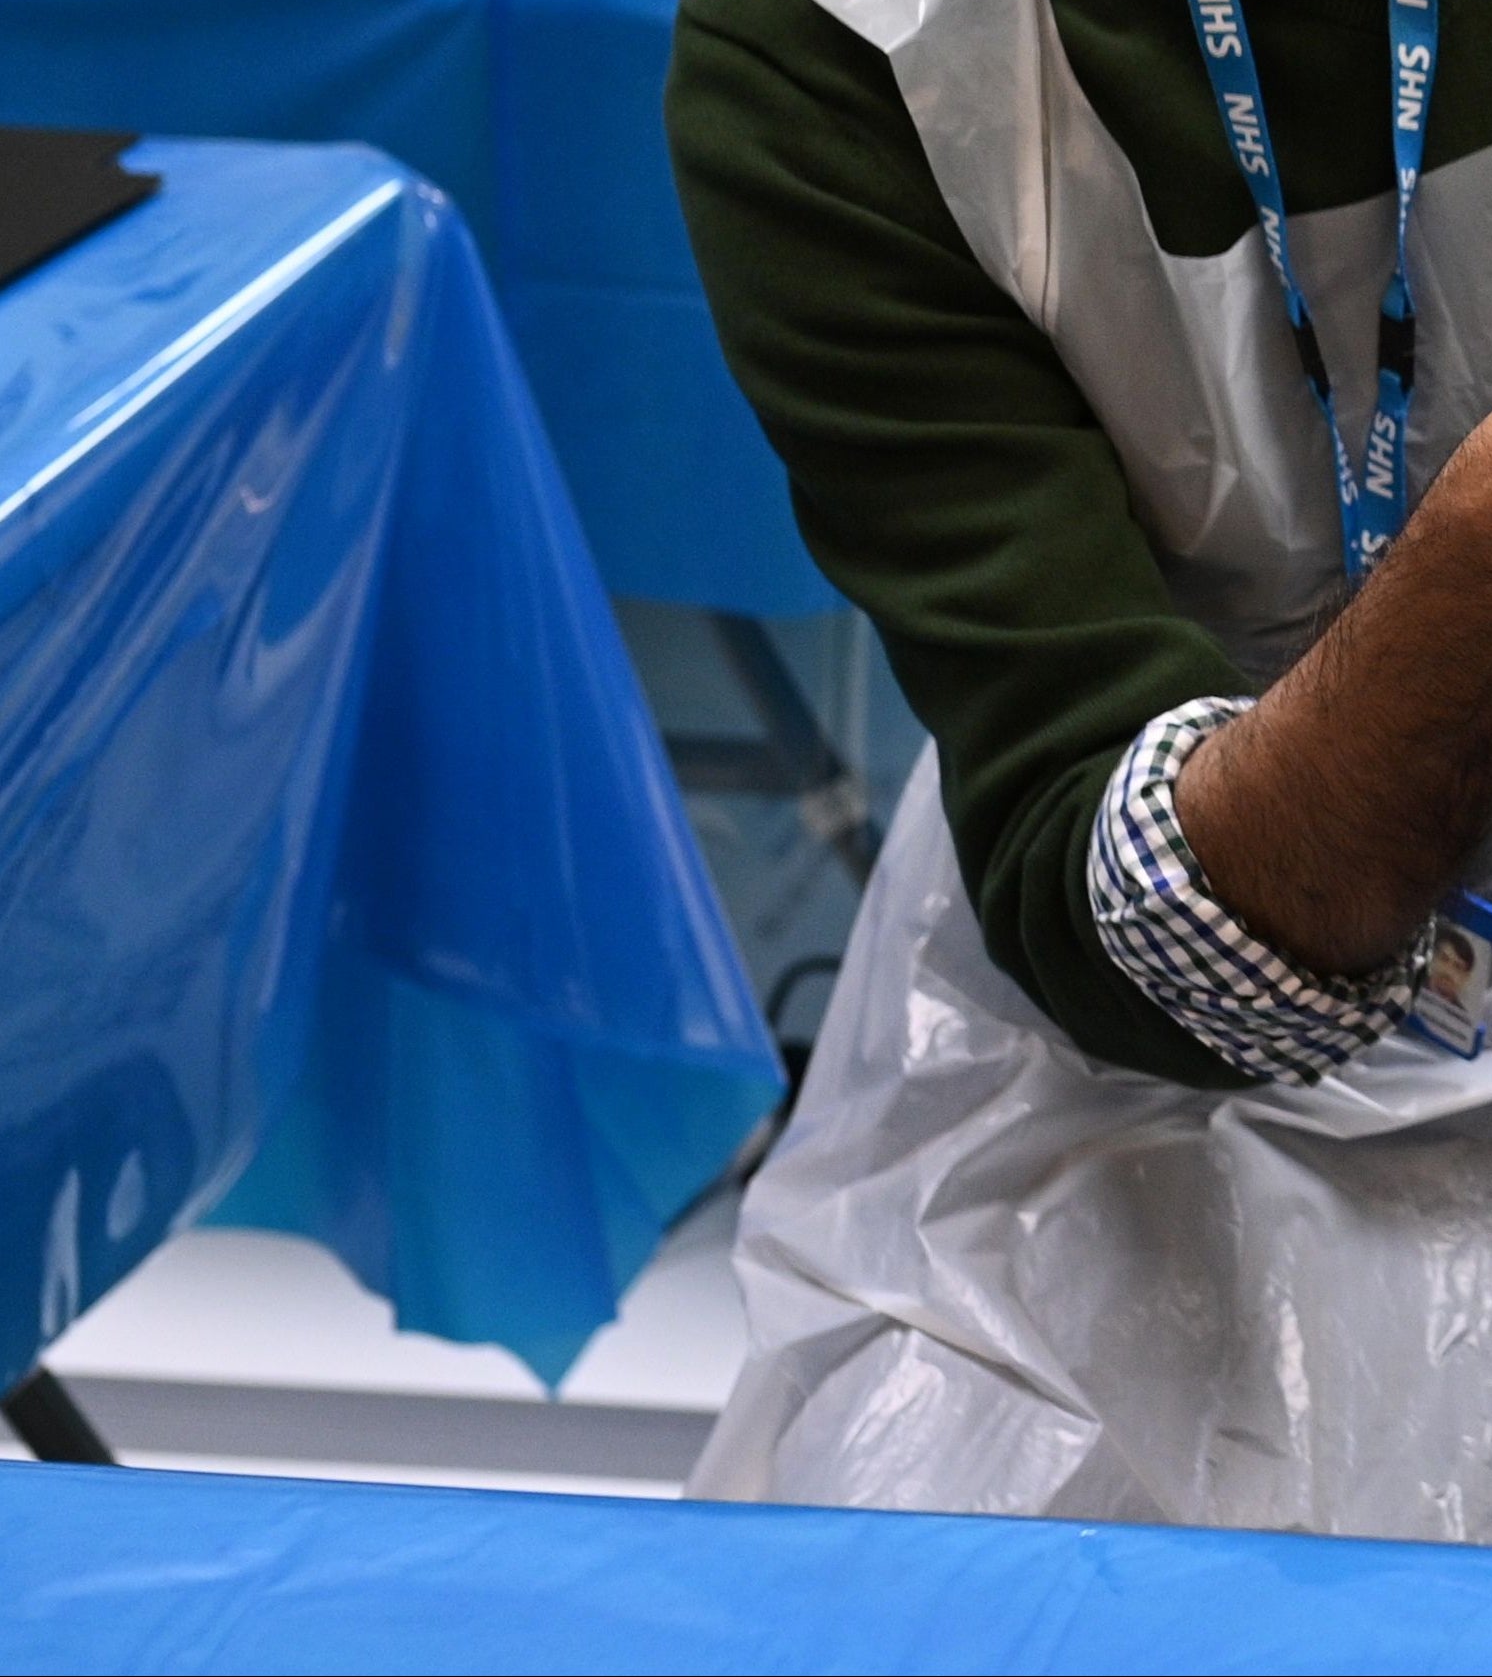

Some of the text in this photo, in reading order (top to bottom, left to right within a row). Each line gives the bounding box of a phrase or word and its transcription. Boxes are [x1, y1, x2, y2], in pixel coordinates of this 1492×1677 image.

[1398, 42, 1430, 131] NHS
[1224, 91, 1270, 179] NHS
[1365, 410, 1397, 500] NHS
